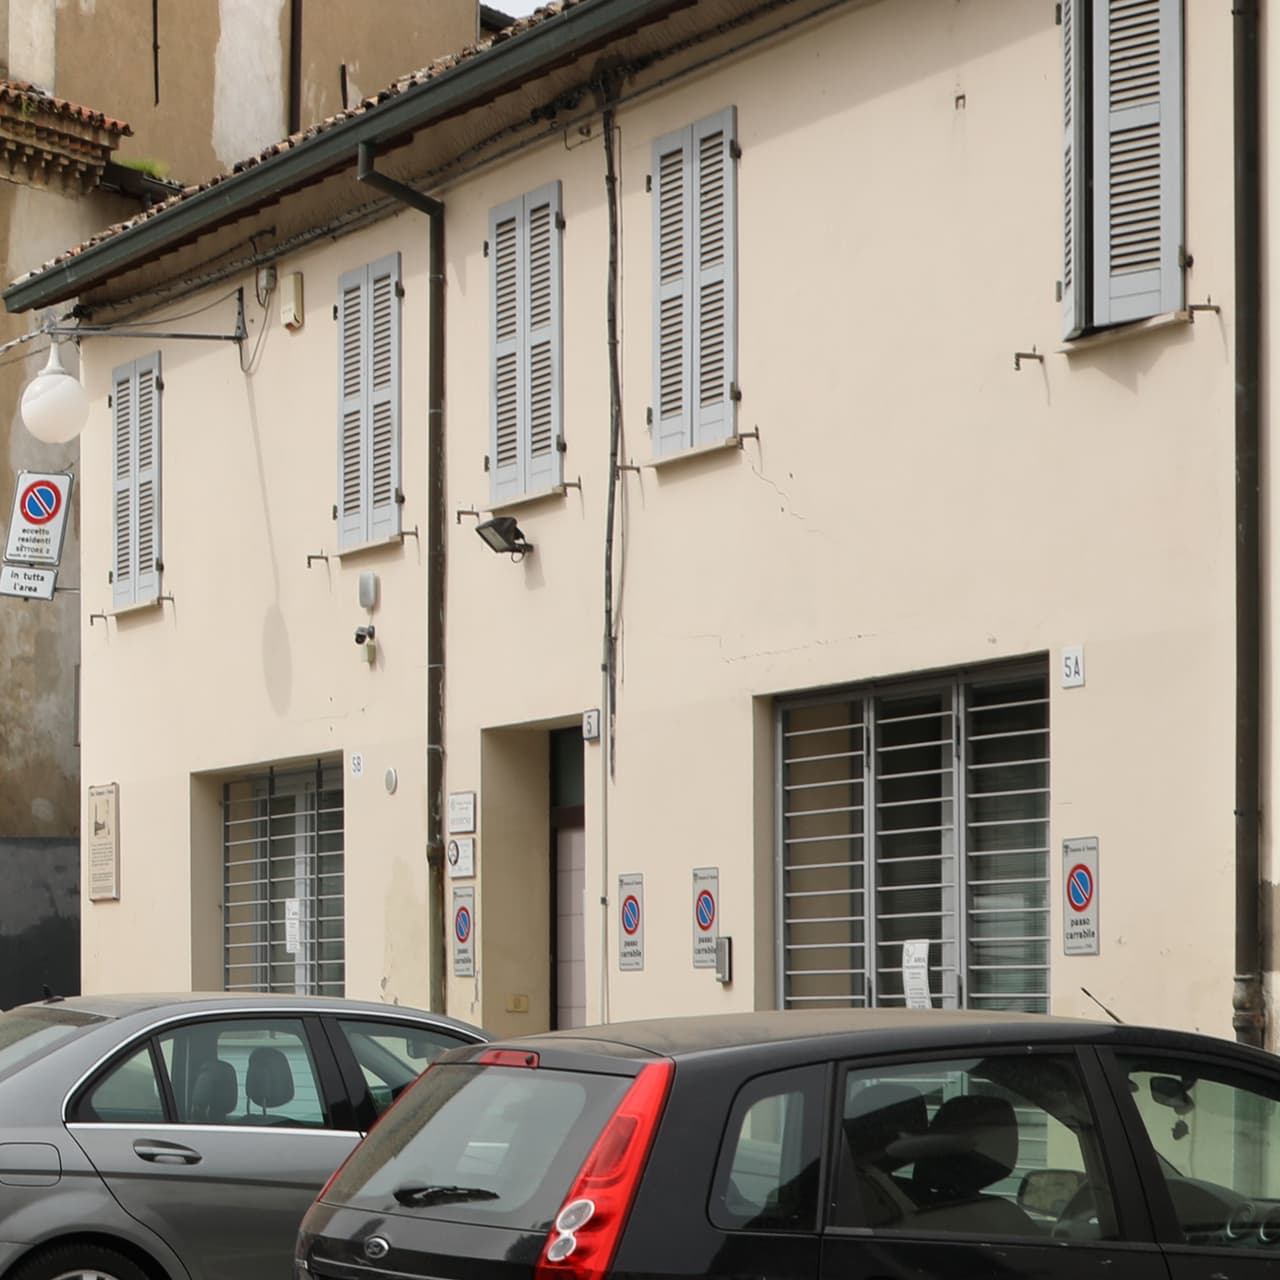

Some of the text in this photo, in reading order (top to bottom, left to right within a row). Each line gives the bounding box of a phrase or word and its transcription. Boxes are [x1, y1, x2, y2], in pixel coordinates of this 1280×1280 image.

[18, 536, 51, 544] residenti
[24, 572, 44, 581] tutta
[13, 582, 38, 592] l'area
[1064, 656, 1081, 678] 5A
[586, 715, 592, 735] 5
[1070, 918, 1090, 928] passo
[1066, 929, 1095, 940] carrabile
